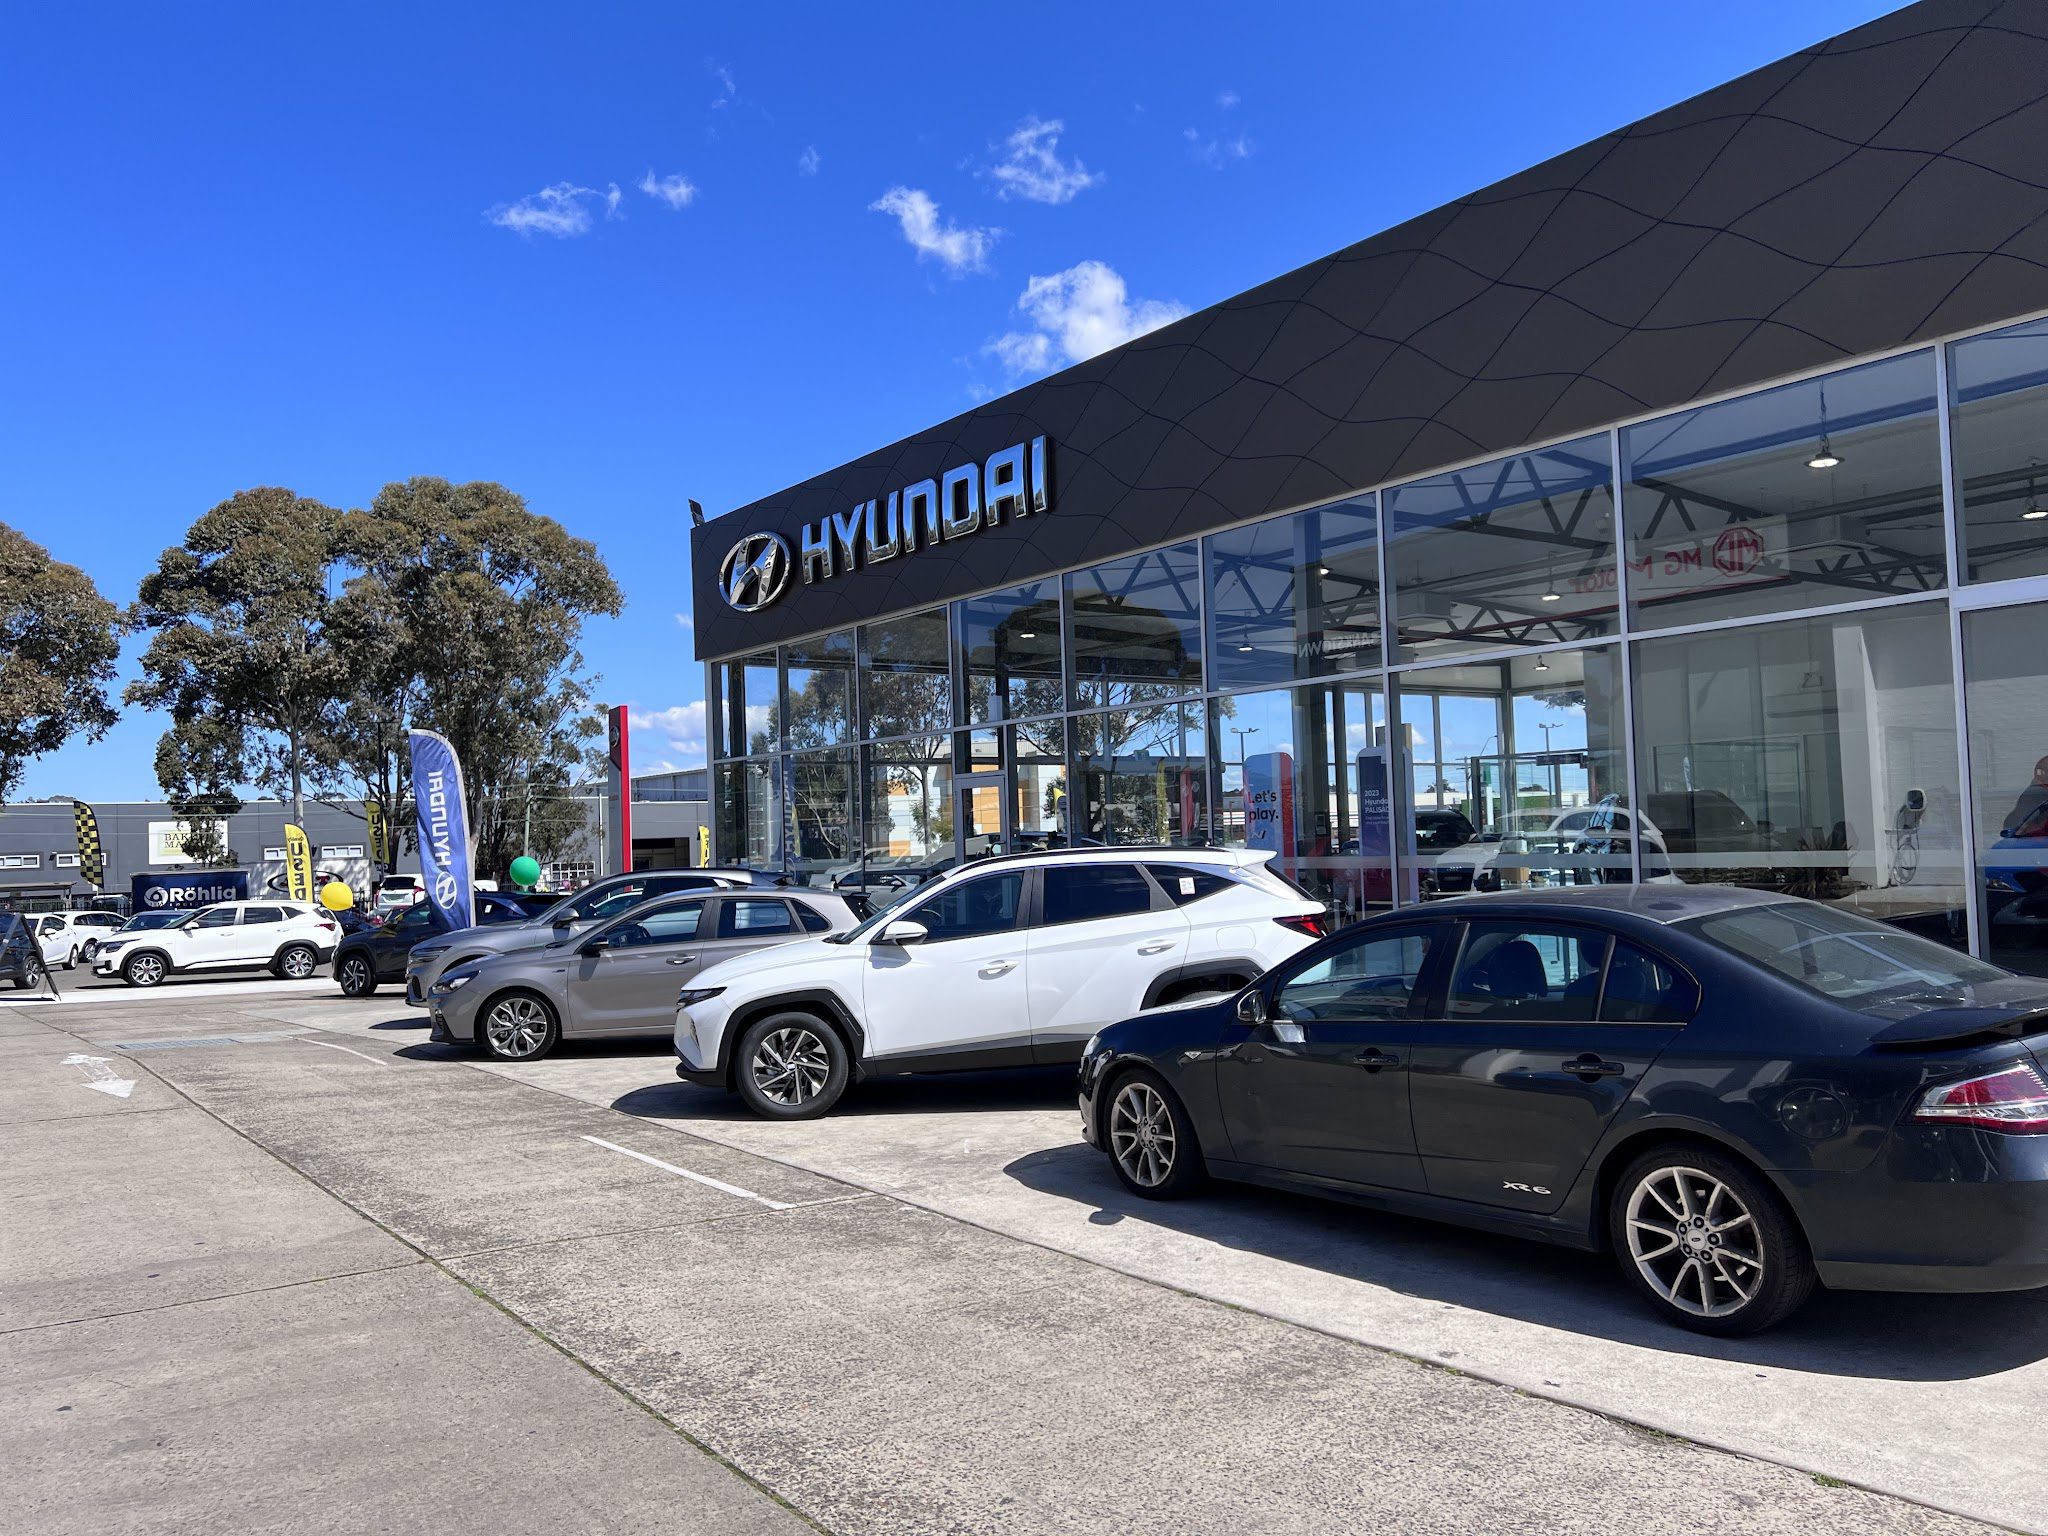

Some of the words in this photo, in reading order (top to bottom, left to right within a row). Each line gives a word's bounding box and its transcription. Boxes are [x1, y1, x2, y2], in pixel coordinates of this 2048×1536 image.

[801, 435, 1047, 585] HYUNDAI
[1247, 789, 1277, 804] Let's
[1364, 798, 1389, 806] Hyunda
[1248, 807, 1280, 823] play.
[169, 885, 237, 902] Röhlig
[1502, 1181, 1552, 1195] XR6
